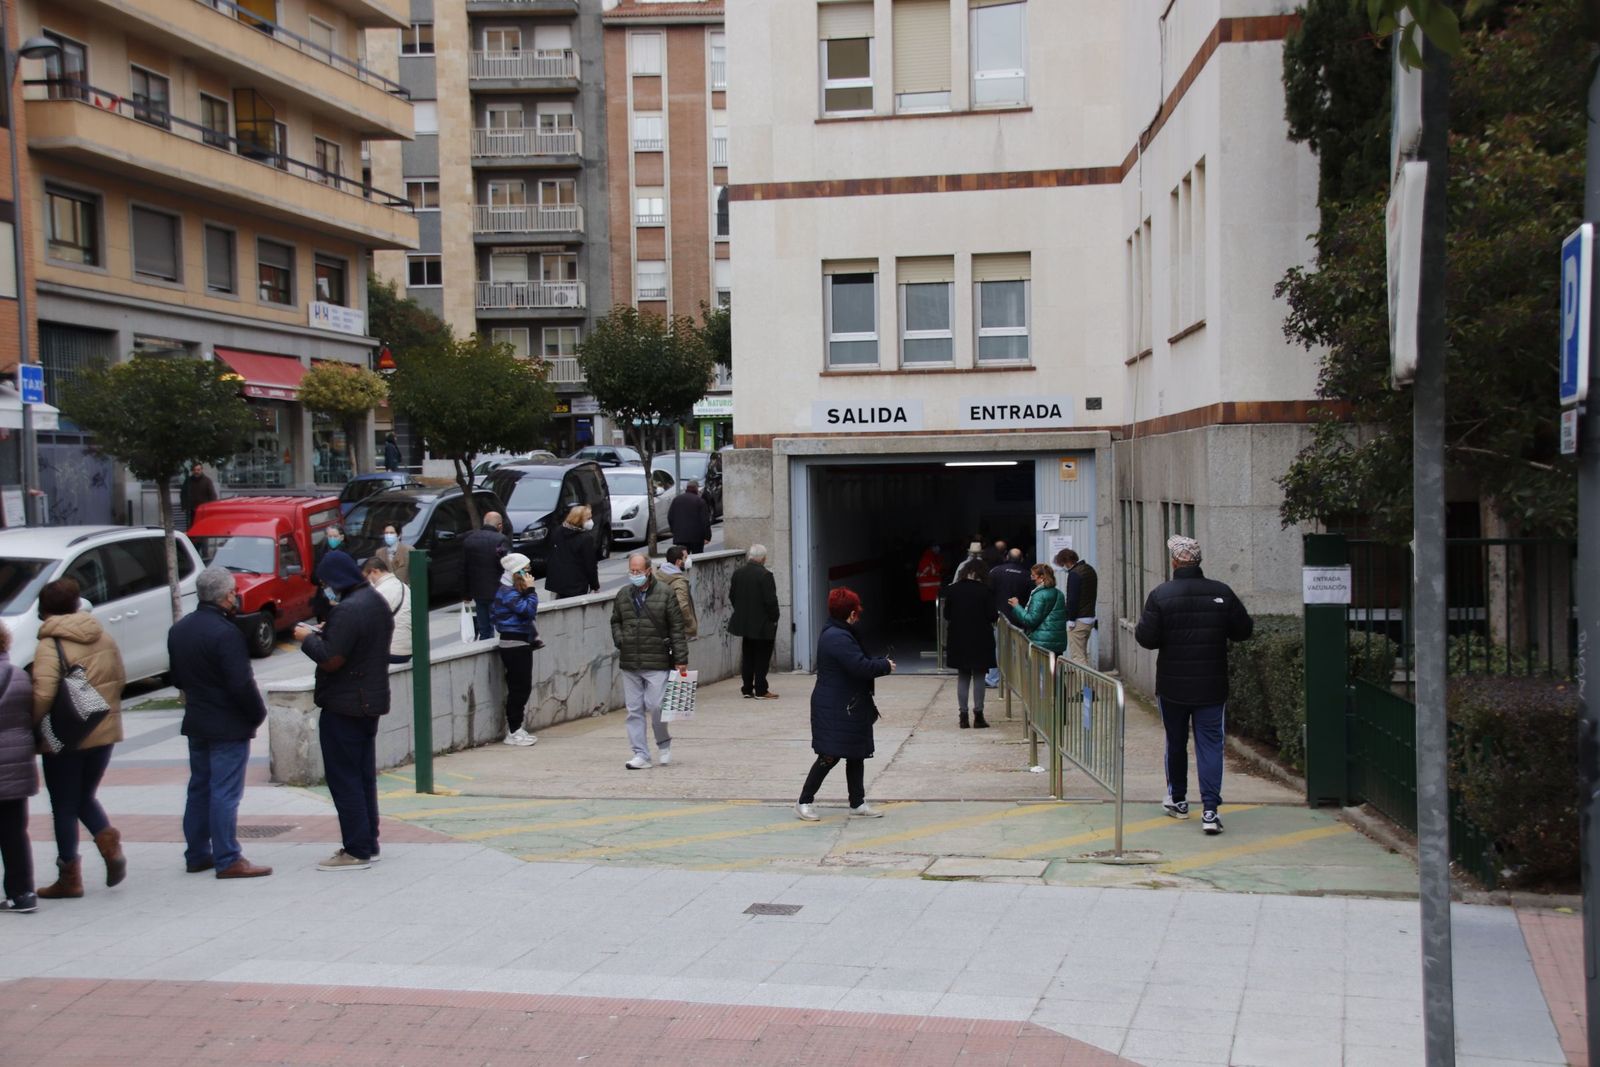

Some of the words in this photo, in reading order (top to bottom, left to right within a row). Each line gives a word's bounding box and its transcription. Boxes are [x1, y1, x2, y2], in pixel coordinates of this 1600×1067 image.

[1563, 255, 1577, 383] P
[23, 378, 43, 391] TAXI
[826, 406, 908, 424] SALIDA
[970, 404, 1062, 421] ENTRADA
